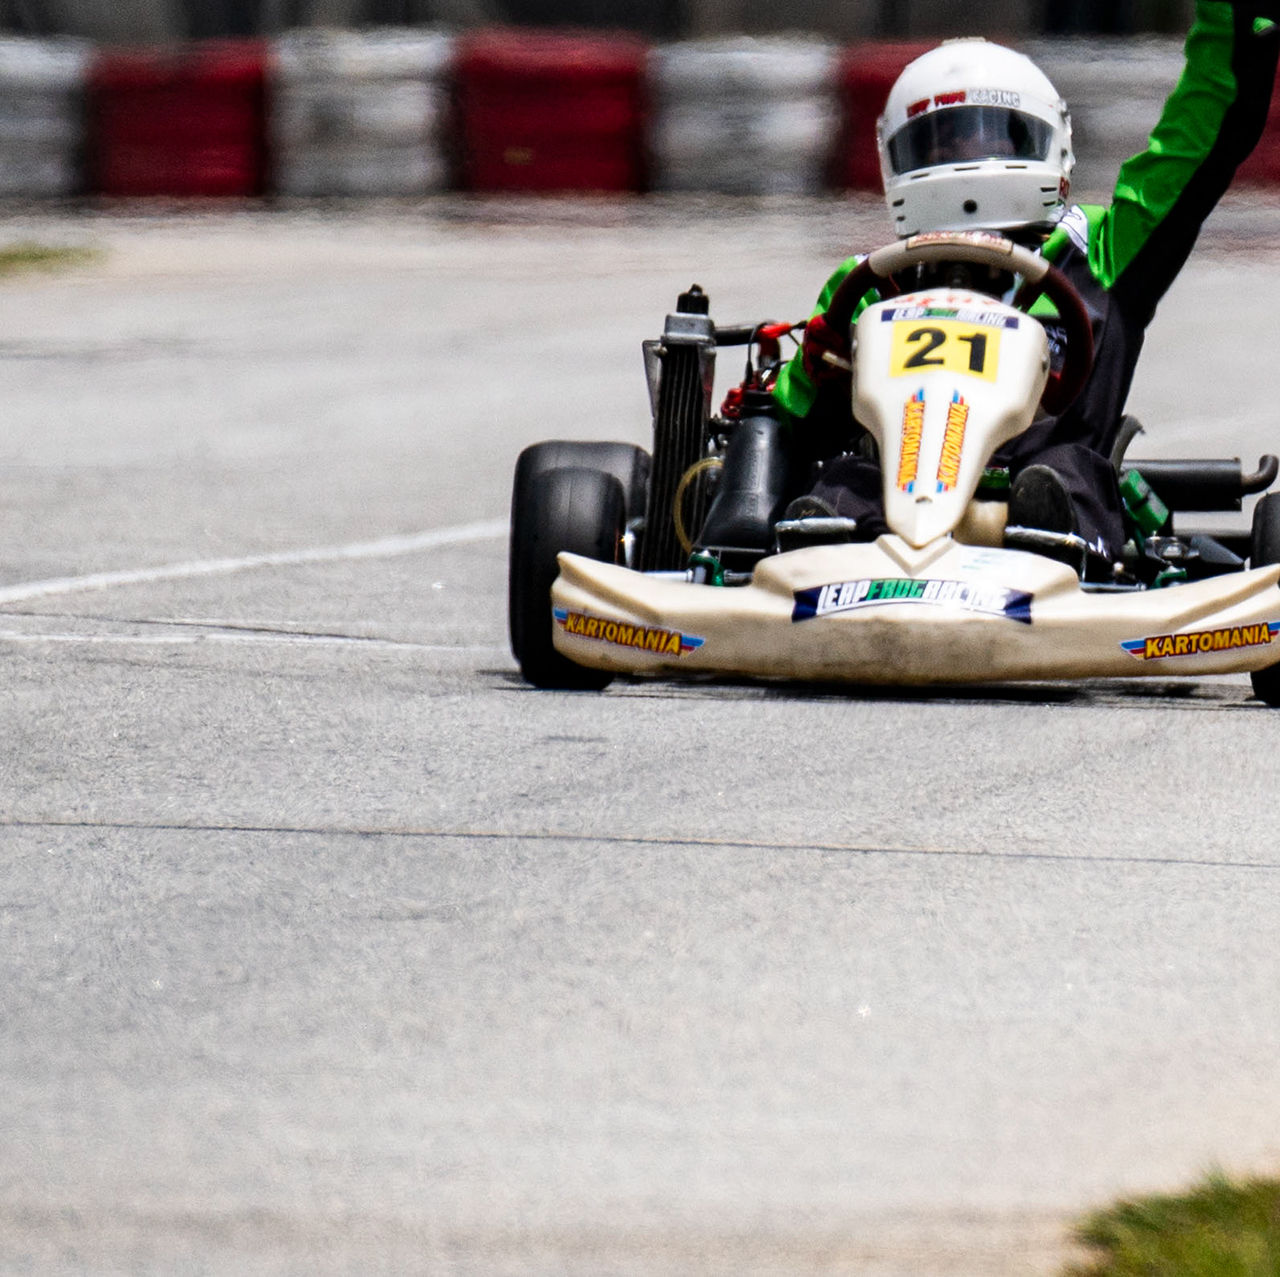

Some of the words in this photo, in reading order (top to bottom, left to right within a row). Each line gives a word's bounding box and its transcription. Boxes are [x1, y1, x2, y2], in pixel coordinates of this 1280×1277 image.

[903, 326, 988, 374] 21
[936, 402, 970, 488] KARTOMANIA
[564, 611, 683, 657] KARTOMANIA
[1144, 622, 1273, 660] KARTOMANIA
